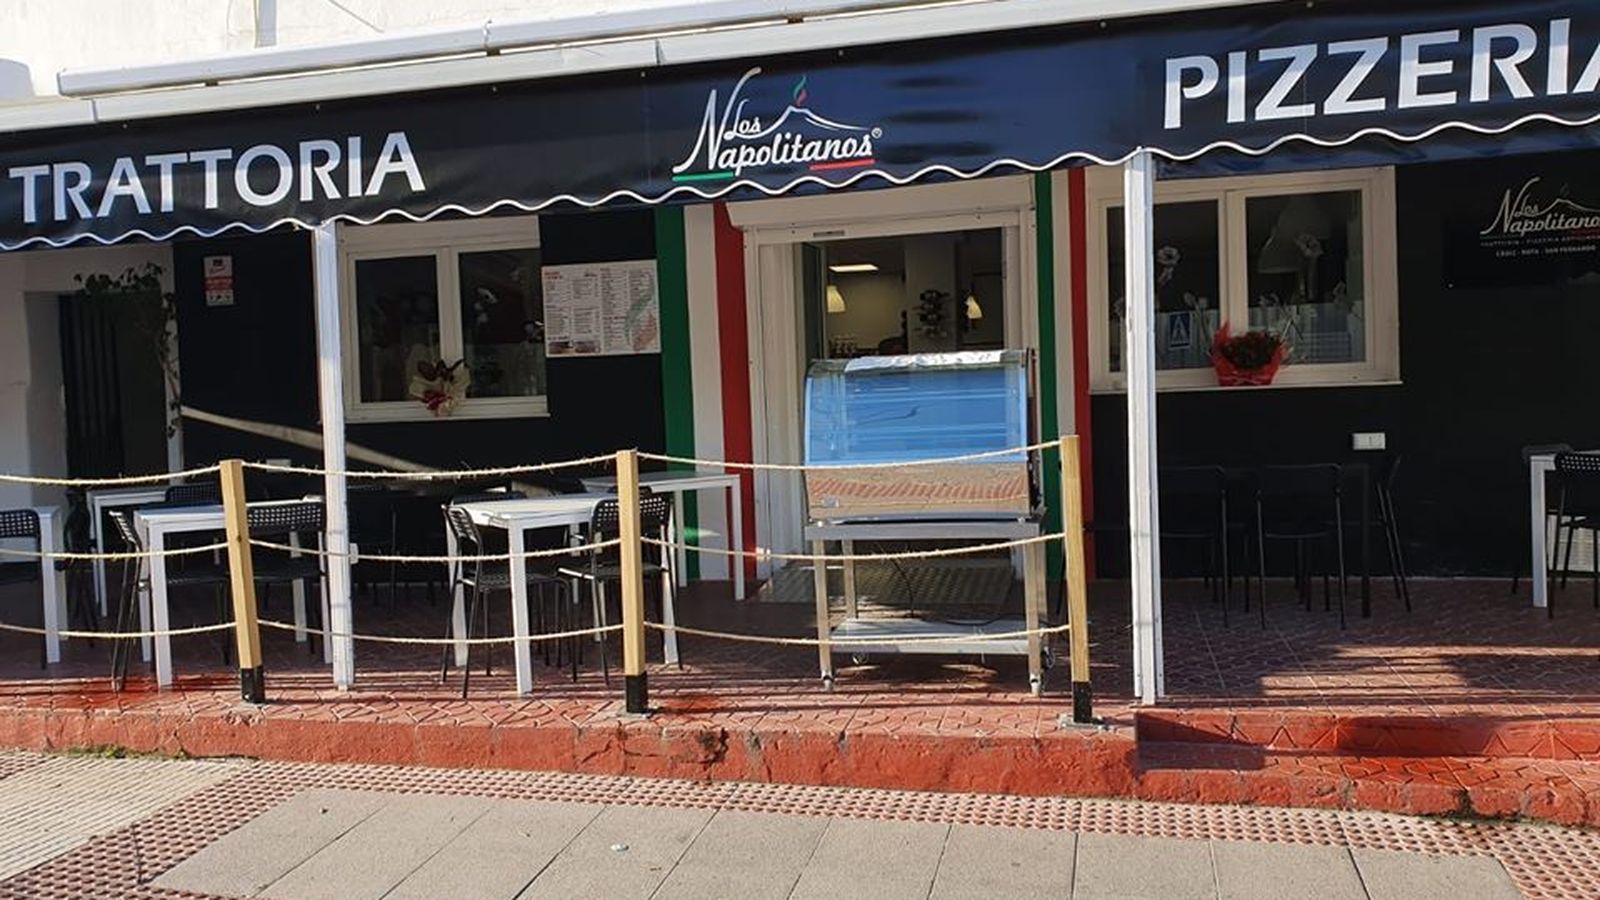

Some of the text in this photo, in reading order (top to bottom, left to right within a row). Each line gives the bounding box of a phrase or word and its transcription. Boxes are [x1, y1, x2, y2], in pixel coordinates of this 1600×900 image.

[672, 67, 873, 176] Napolitanos
[723, 98, 762, 140] Los
[8, 131, 426, 224] TRATTORIA
